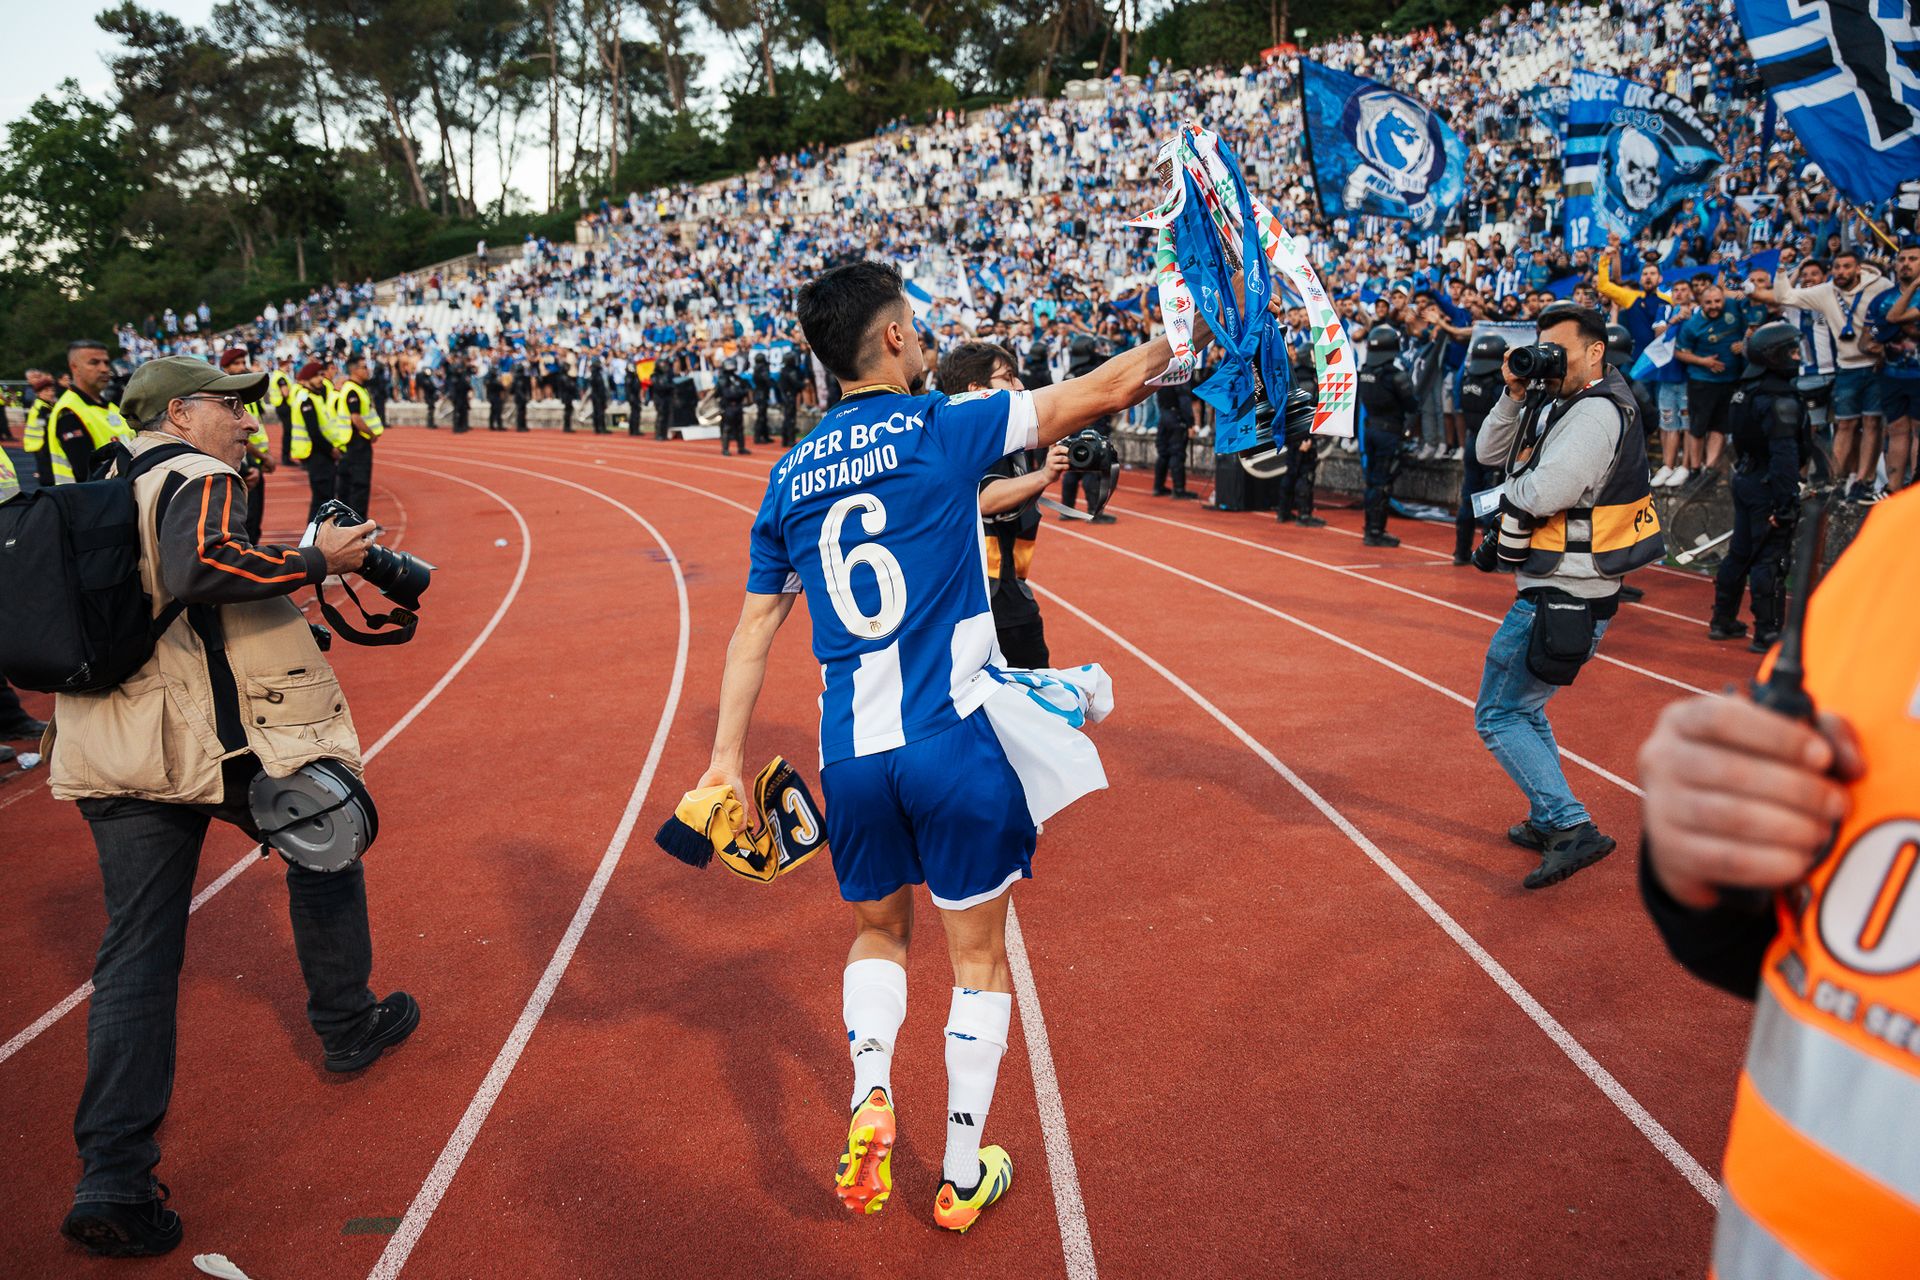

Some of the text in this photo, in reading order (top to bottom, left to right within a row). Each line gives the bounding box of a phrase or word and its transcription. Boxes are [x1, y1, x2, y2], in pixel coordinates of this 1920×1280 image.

[777, 410, 924, 485] SUPER BOCK
[791, 444, 898, 502] EUSTÁQUIO
[818, 493, 907, 640] 6
